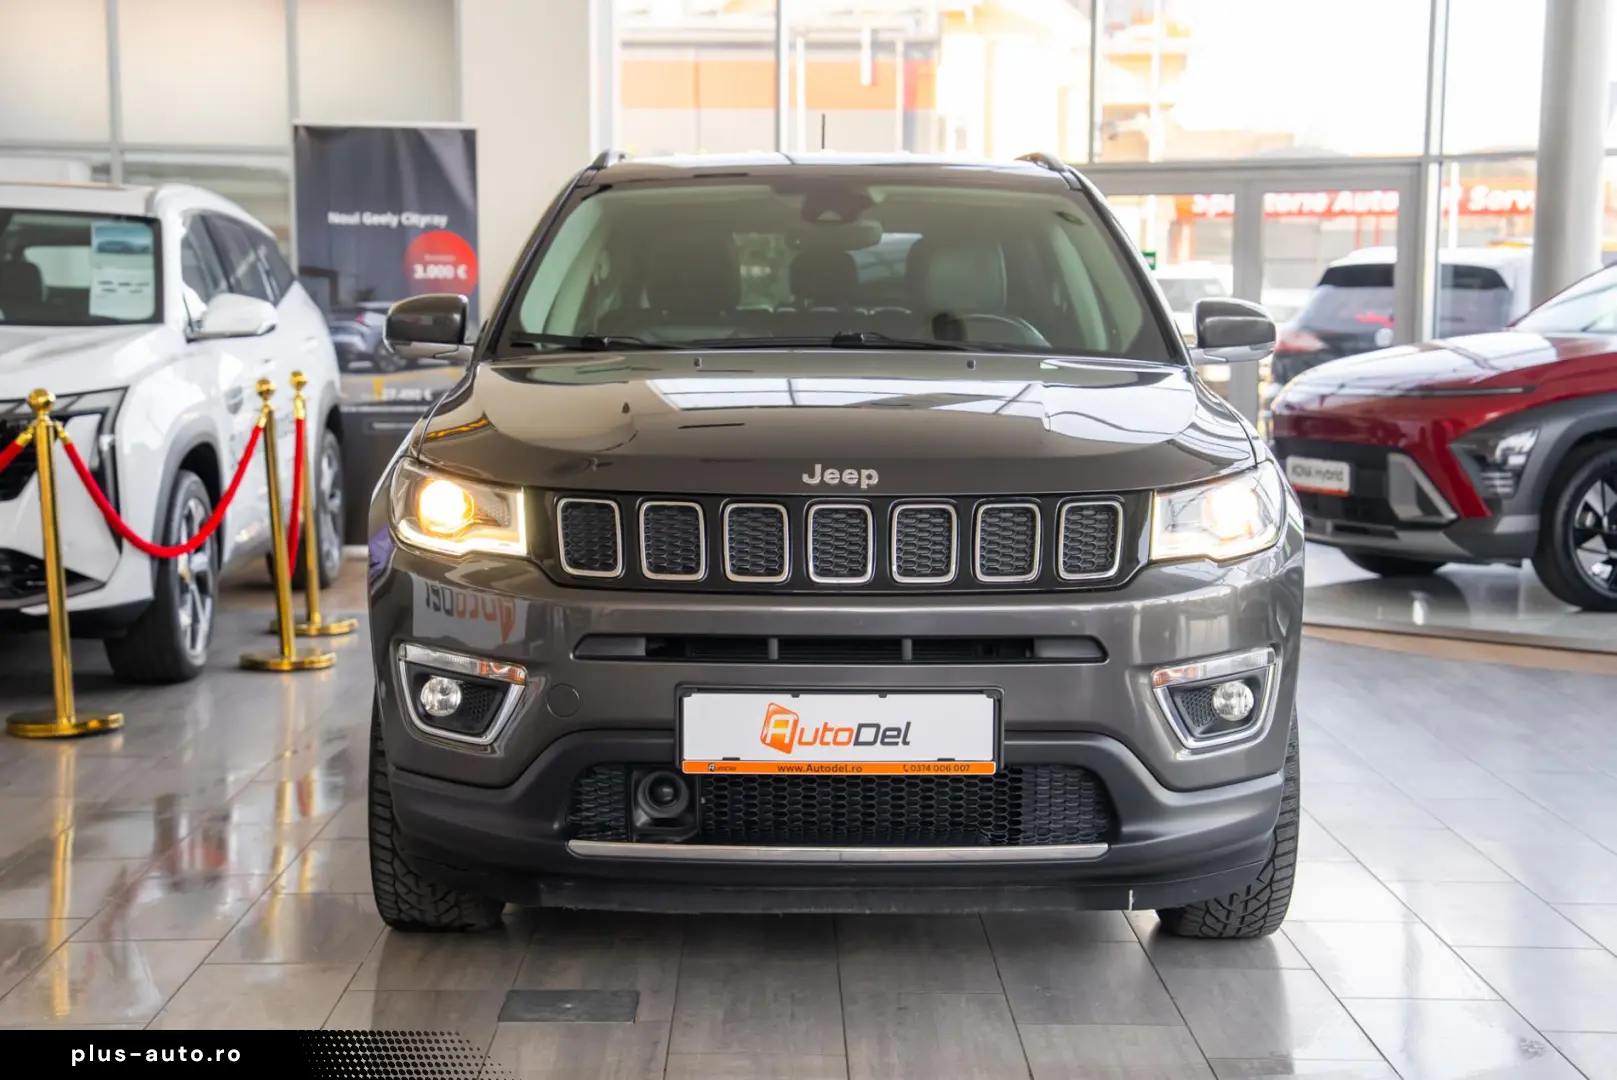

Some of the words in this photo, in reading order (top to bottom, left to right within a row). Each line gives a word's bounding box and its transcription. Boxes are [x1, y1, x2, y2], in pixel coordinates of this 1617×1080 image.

[802, 464, 879, 489] Jeep
[761, 705, 911, 752] AutoDel
[777, 764, 863, 773] www.Autodel.ro
[910, 764, 931, 772] 0374
[933, 764, 951, 772] 006
[953, 764, 970, 772] 007
